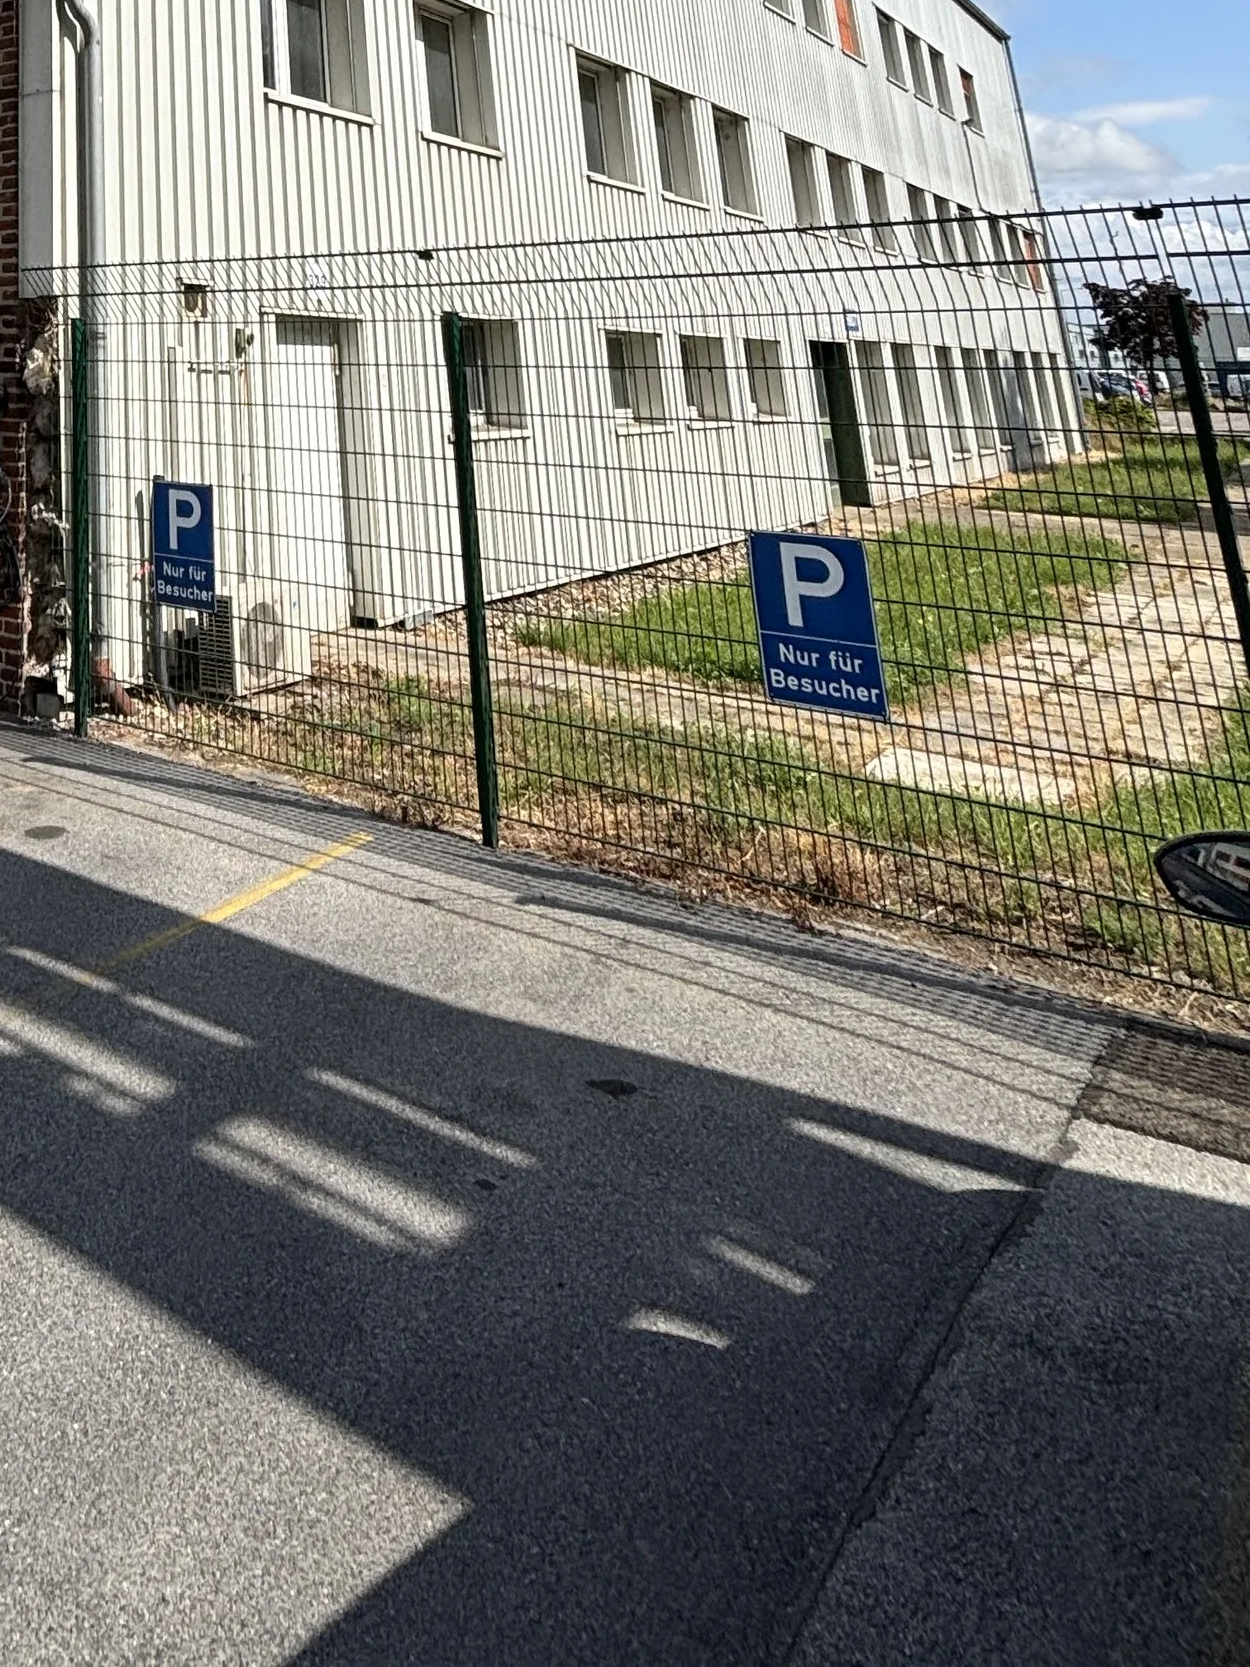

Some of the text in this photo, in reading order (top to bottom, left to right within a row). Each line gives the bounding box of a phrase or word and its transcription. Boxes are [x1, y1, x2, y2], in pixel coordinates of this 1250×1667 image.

[168, 488, 202, 550] P
[162, 561, 207, 582] Nur für
[779, 541, 845, 628] P
[157, 579, 213, 602] Besucher
[778, 642, 863, 674] Nur für
[769, 667, 880, 704] Besucher
